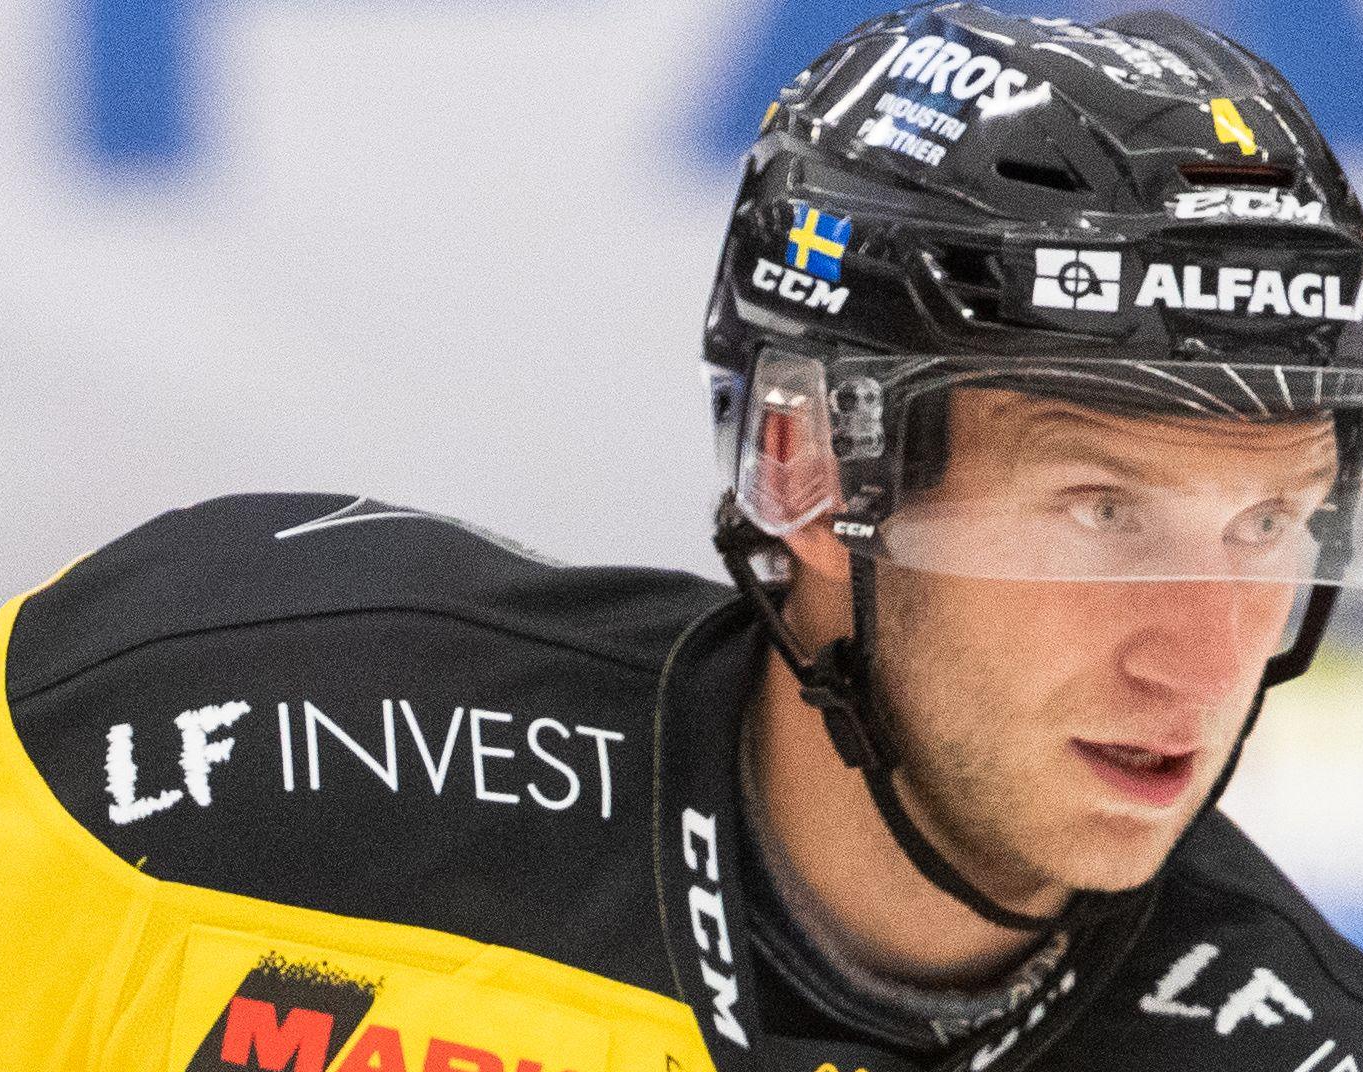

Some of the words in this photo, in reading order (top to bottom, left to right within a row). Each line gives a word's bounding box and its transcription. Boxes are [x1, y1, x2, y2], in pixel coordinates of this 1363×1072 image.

[856, 118, 947, 167] PTNER
[1210, 97, 1258, 156] 4
[752, 257, 850, 315] CCM
[105, 700, 251, 825] LF
[277, 700, 626, 820] INVEST
[681, 807, 751, 1049] CCM
[1139, 942, 1313, 1035] LF
